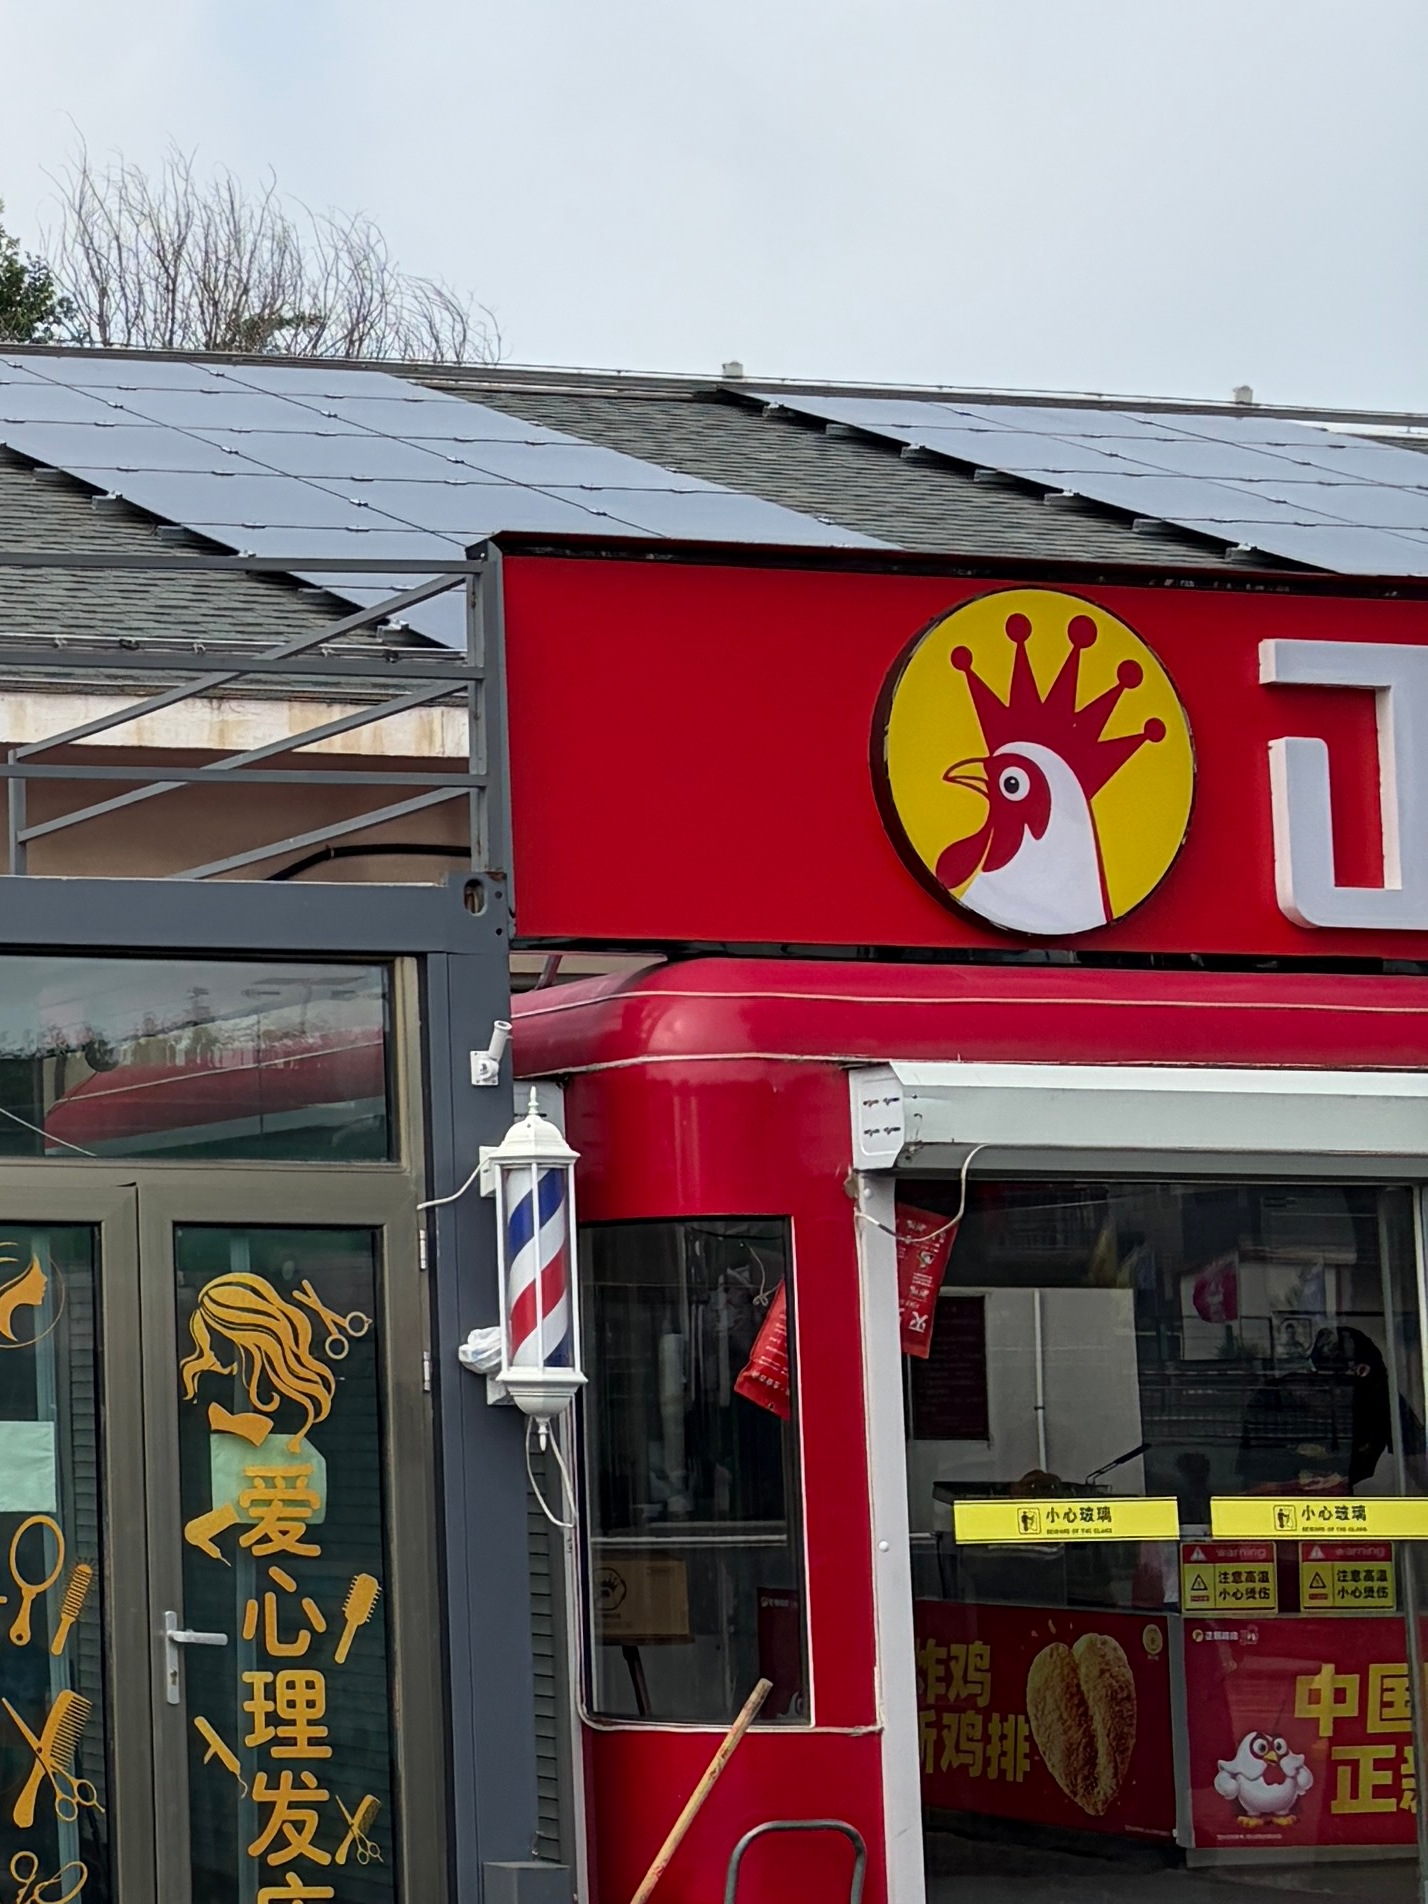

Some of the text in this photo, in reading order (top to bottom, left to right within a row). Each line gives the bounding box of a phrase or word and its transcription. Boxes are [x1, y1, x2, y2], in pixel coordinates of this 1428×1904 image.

[1046, 1506, 1112, 1523] 小心玻璃
[1301, 1504, 1367, 1521] 小心玻璃
[1218, 1570, 1270, 1584] 注意高温
[1337, 1569, 1387, 1583] 注意高温
[1218, 1587, 1270, 1601] 小心烫伤
[1337, 1586, 1389, 1599] 小心烫伤
[1330, 1744, 1418, 1814] 正
